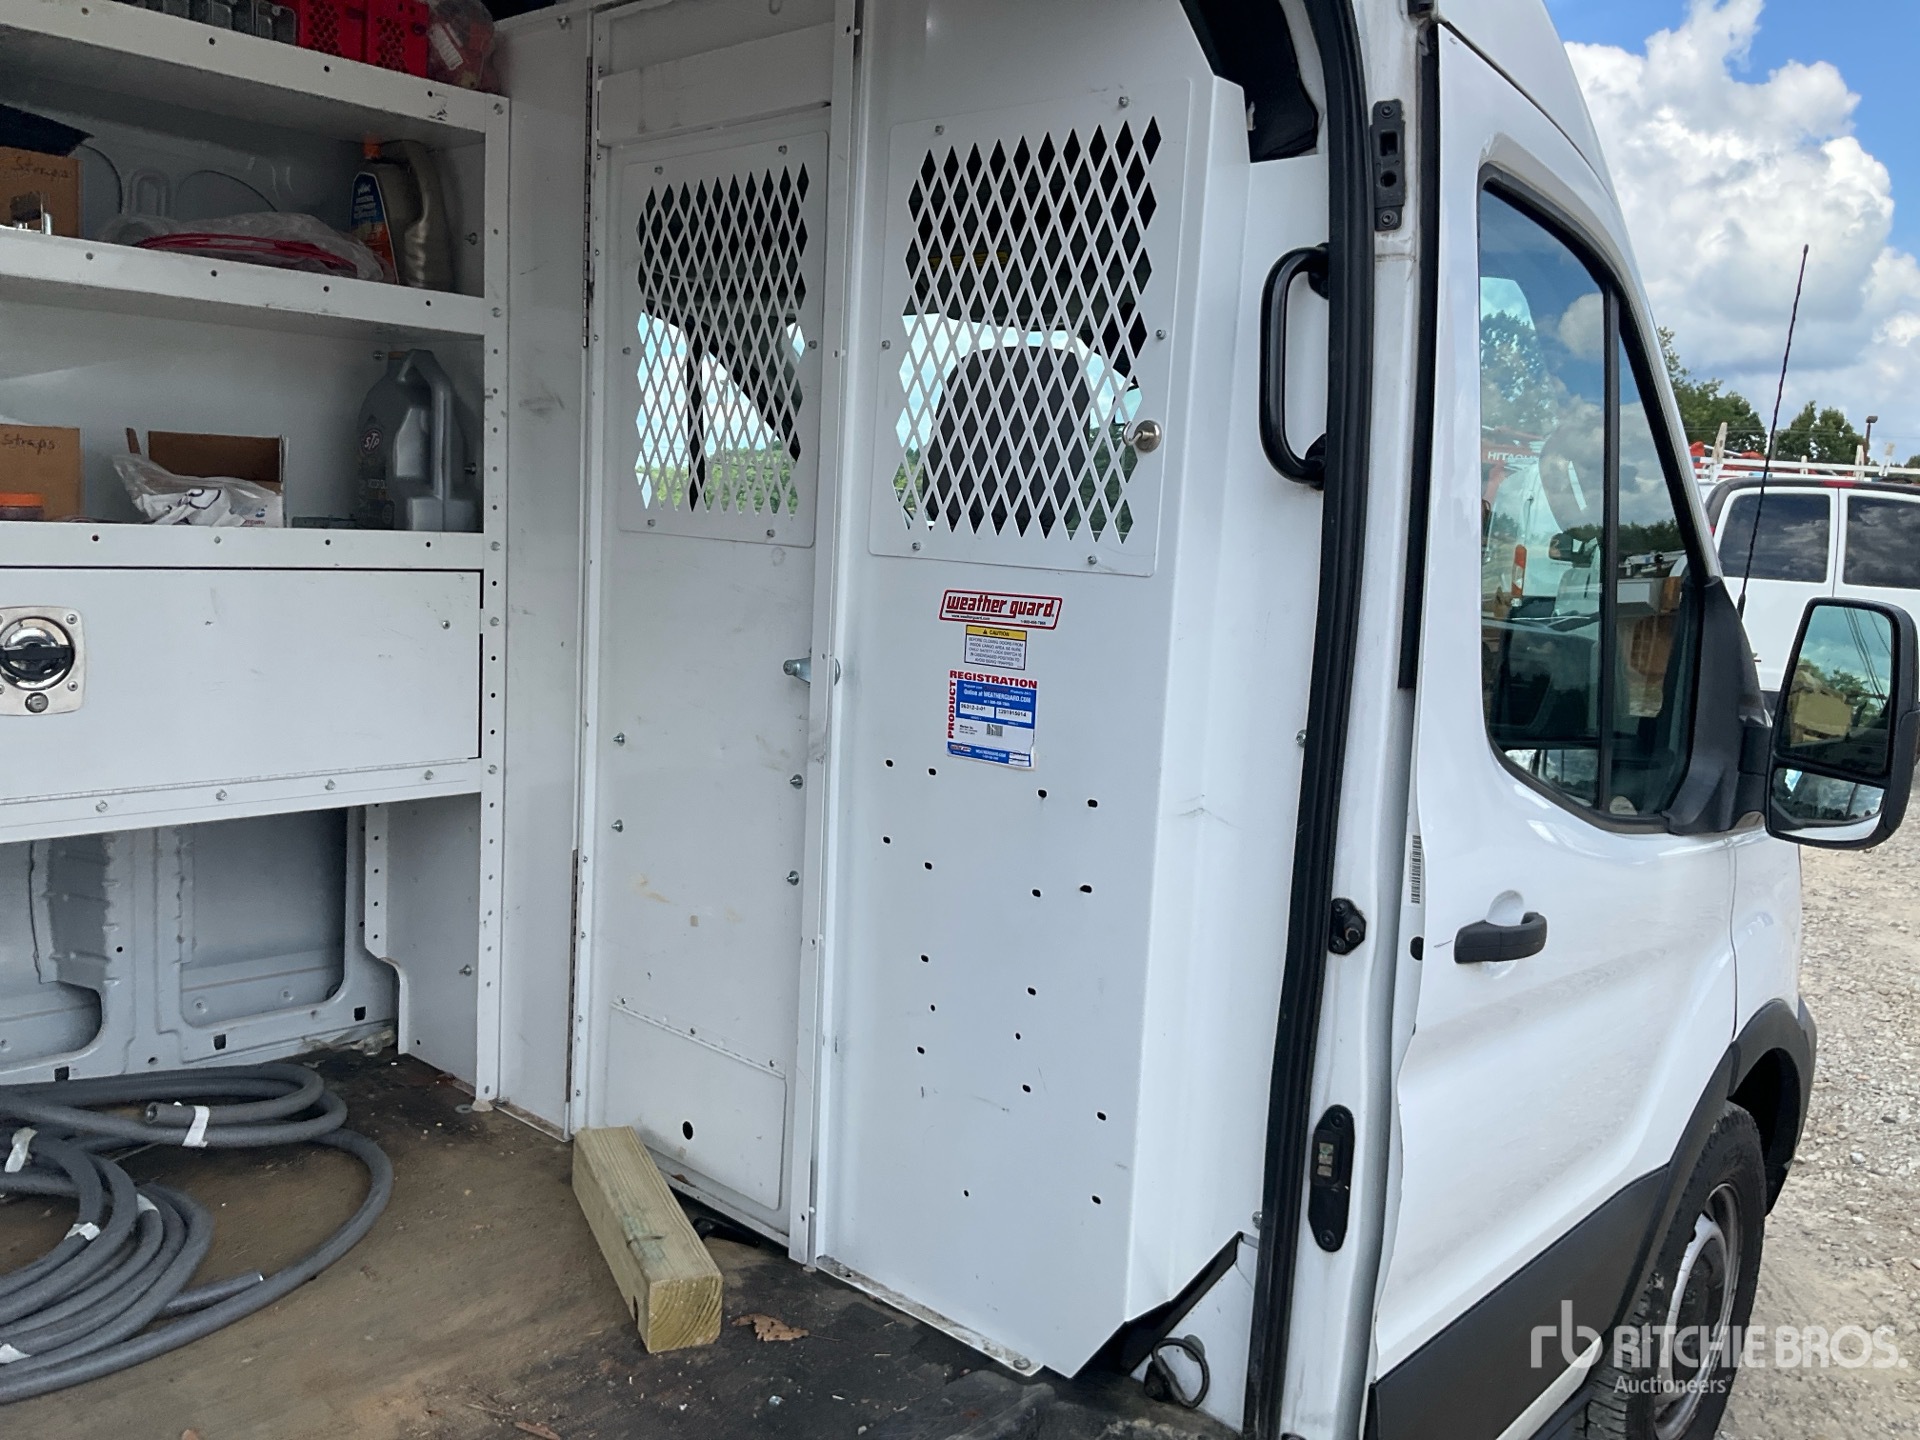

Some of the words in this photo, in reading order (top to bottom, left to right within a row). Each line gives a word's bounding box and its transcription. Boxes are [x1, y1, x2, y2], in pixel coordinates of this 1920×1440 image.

[2, 434, 55, 456] Straps
[364, 432, 380, 451] STP
[946, 595, 1007, 613] weather
[950, 670, 1037, 689] REGISTRATION
[963, 688, 978, 696] Online
[948, 680, 956, 739] PRODUCT
